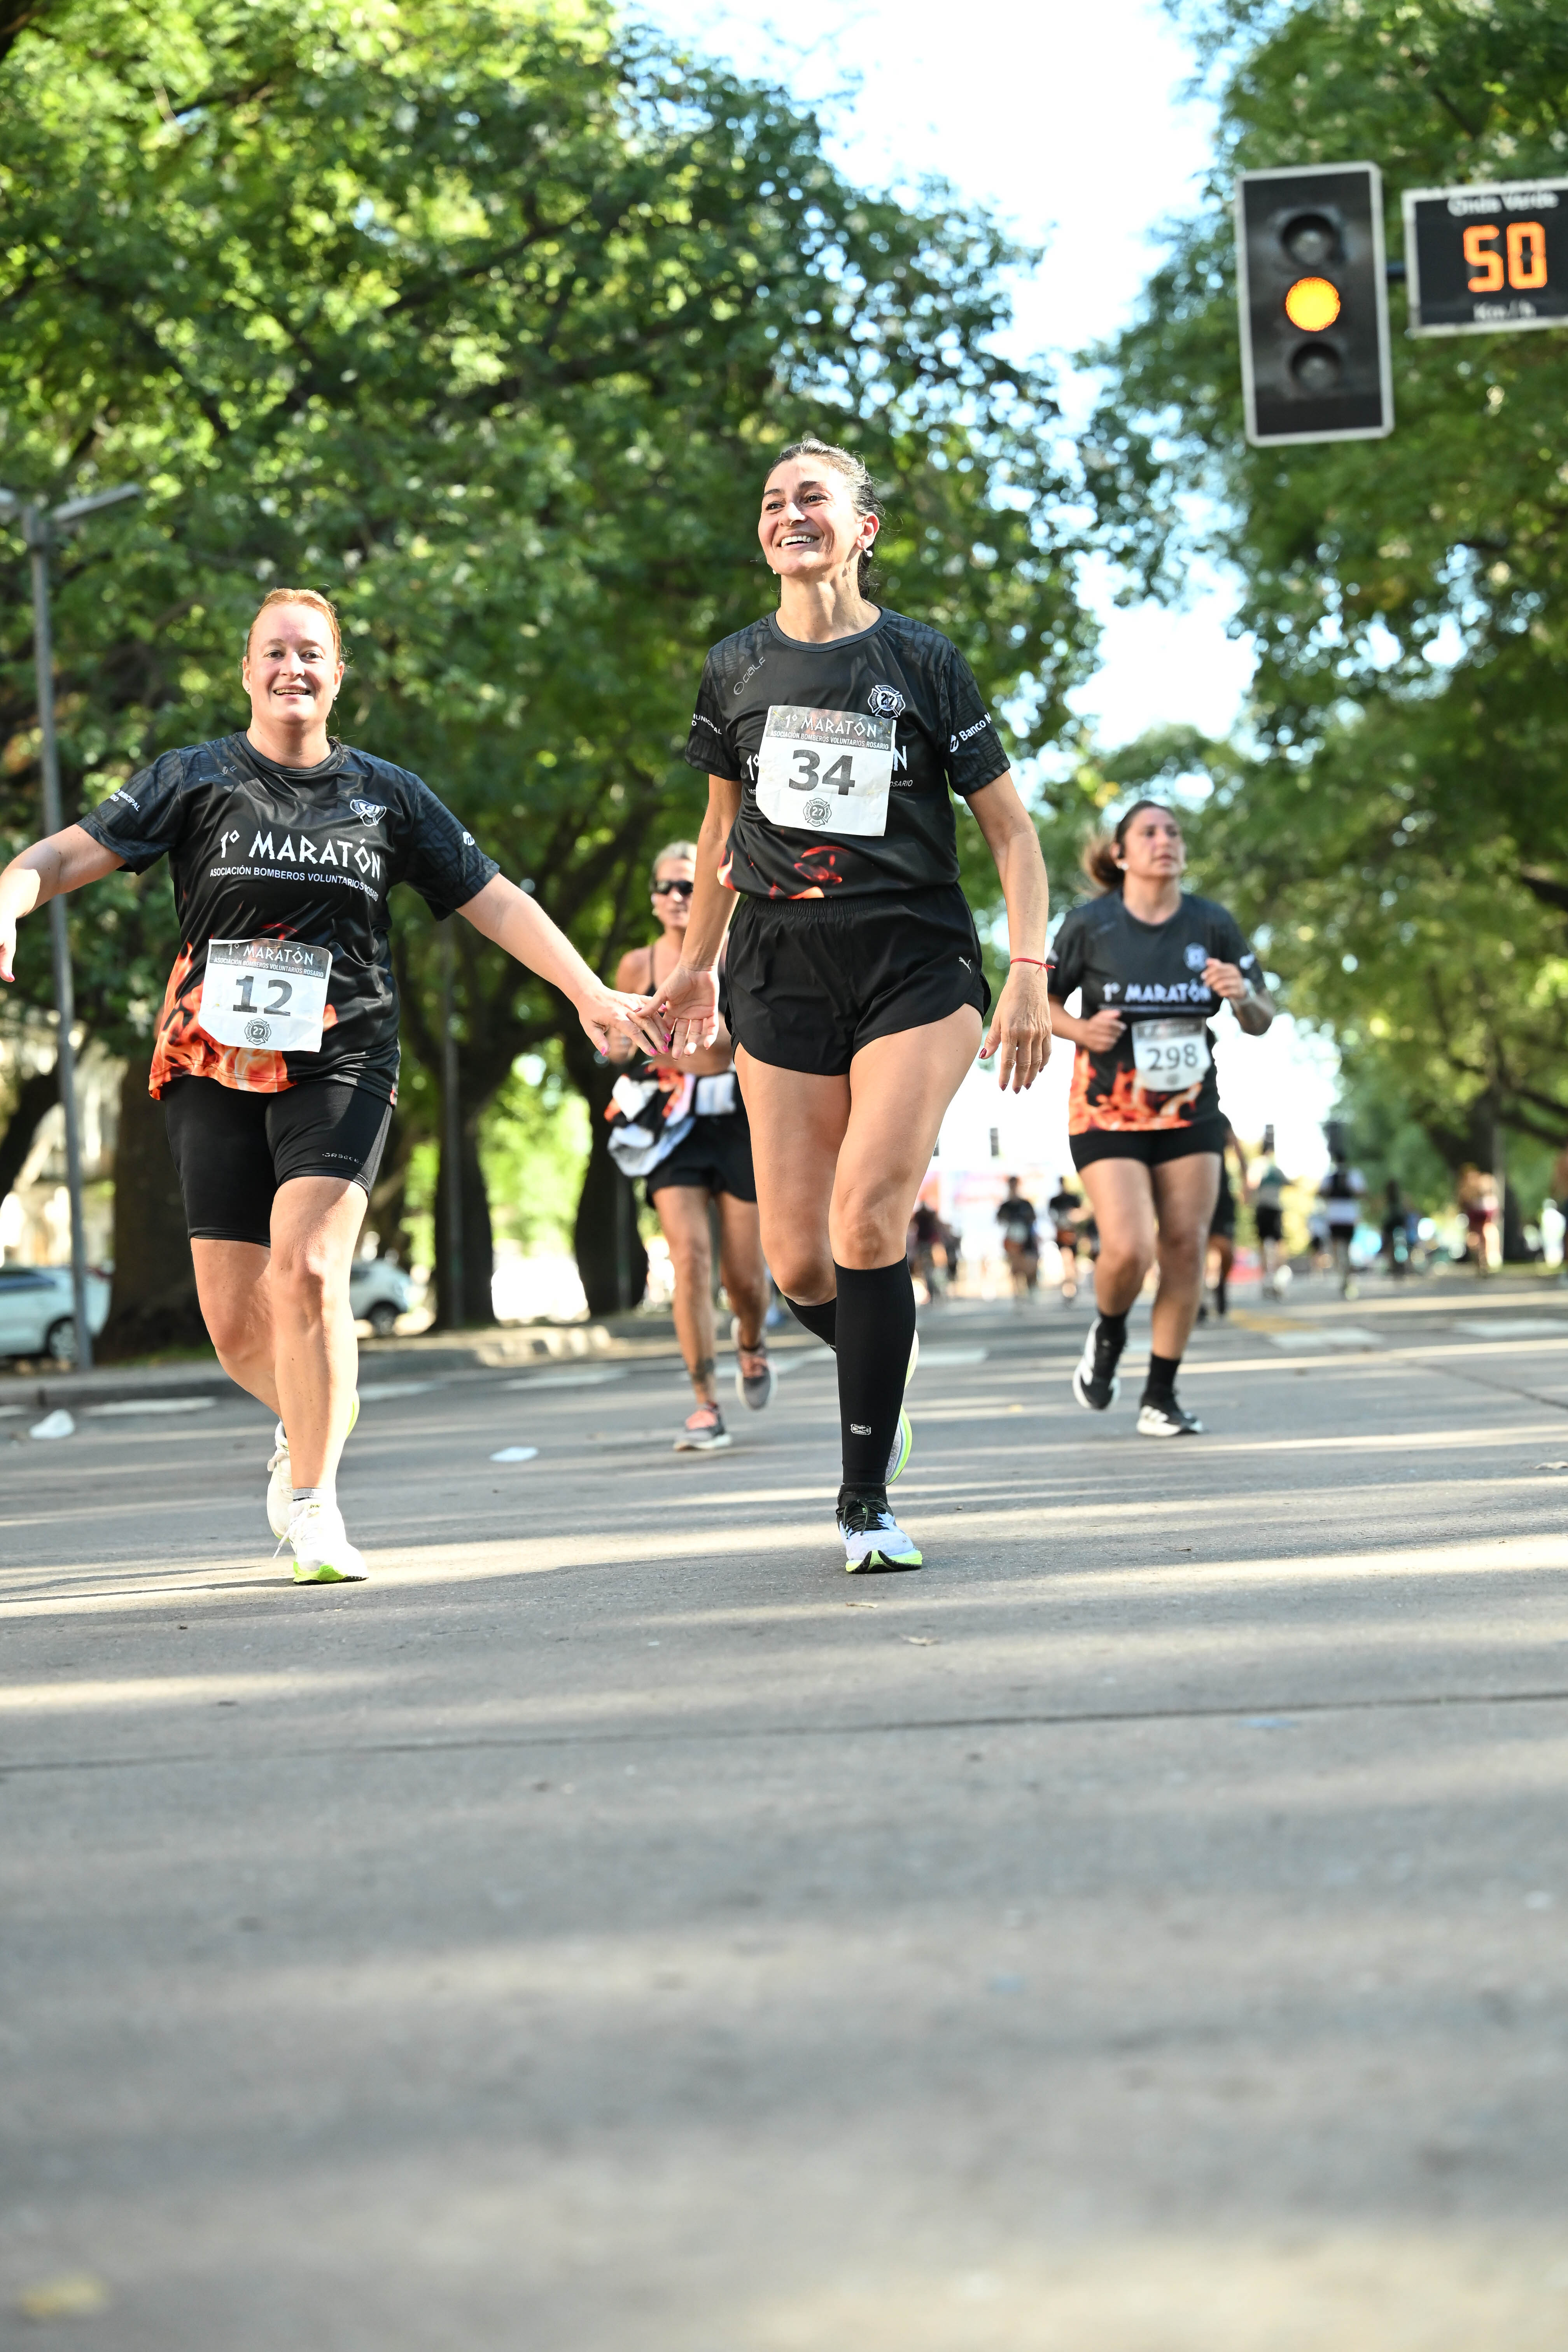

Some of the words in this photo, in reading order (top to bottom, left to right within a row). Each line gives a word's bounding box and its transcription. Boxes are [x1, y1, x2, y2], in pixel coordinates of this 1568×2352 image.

[1463, 221, 1547, 292] 50
[881, 693, 895, 707] 27
[801, 715, 877, 738] MARATÓN
[959, 720, 986, 741] Banco
[801, 733, 829, 743] BOMBEROS
[830, 737, 865, 747] VOLUNTARIOS
[866, 741, 889, 750] ROSARIO
[789, 749, 856, 796] 34
[812, 806, 824, 816] 27
[248, 830, 380, 881] MARATÓN
[210, 865, 251, 877] ASOCIACIÓN
[254, 867, 305, 881] BOMBEROS
[308, 873, 364, 891] VOLUNTARIOS
[364, 884, 379, 902] ROSARIO
[243, 944, 314, 966] MARATÓN
[214, 957, 242, 966] ASOCIACIÓN
[243, 961, 269, 969] BOMBEROS
[270, 964, 303, 974] VOLUNTARIOS
[303, 968, 324, 978] ROSARIO
[233, 975, 292, 1016] 12
[253, 1026, 264, 1035] 27
[1146, 1043, 1198, 1071] 298
